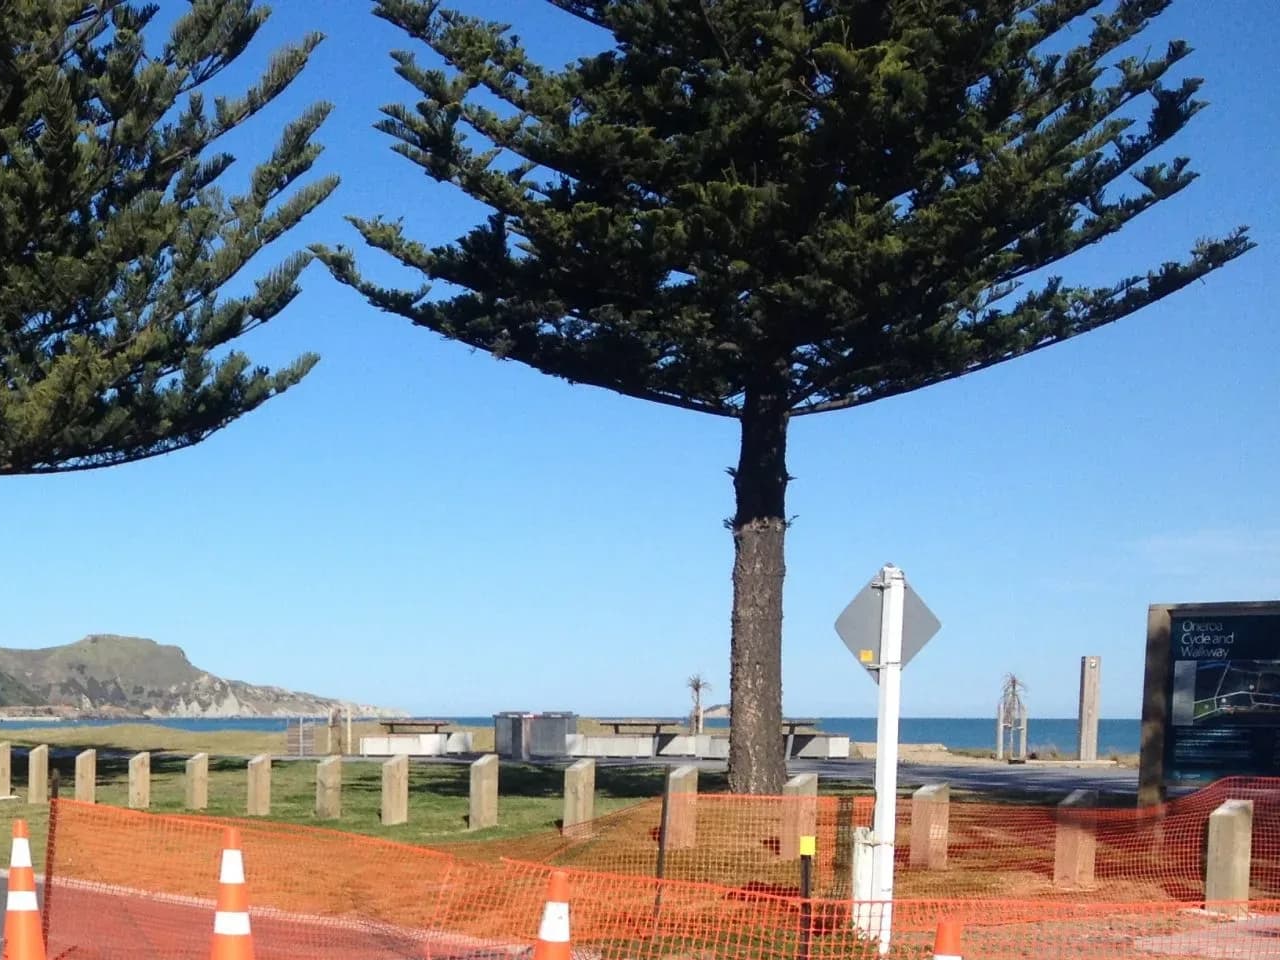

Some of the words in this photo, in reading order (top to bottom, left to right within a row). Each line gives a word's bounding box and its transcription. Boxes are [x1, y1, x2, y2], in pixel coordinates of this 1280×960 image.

[1182, 620, 1223, 632] Oneroa
[1181, 632, 1211, 646] Cycle
[1212, 632, 1234, 644] and
[1181, 646, 1229, 658] Walkway
